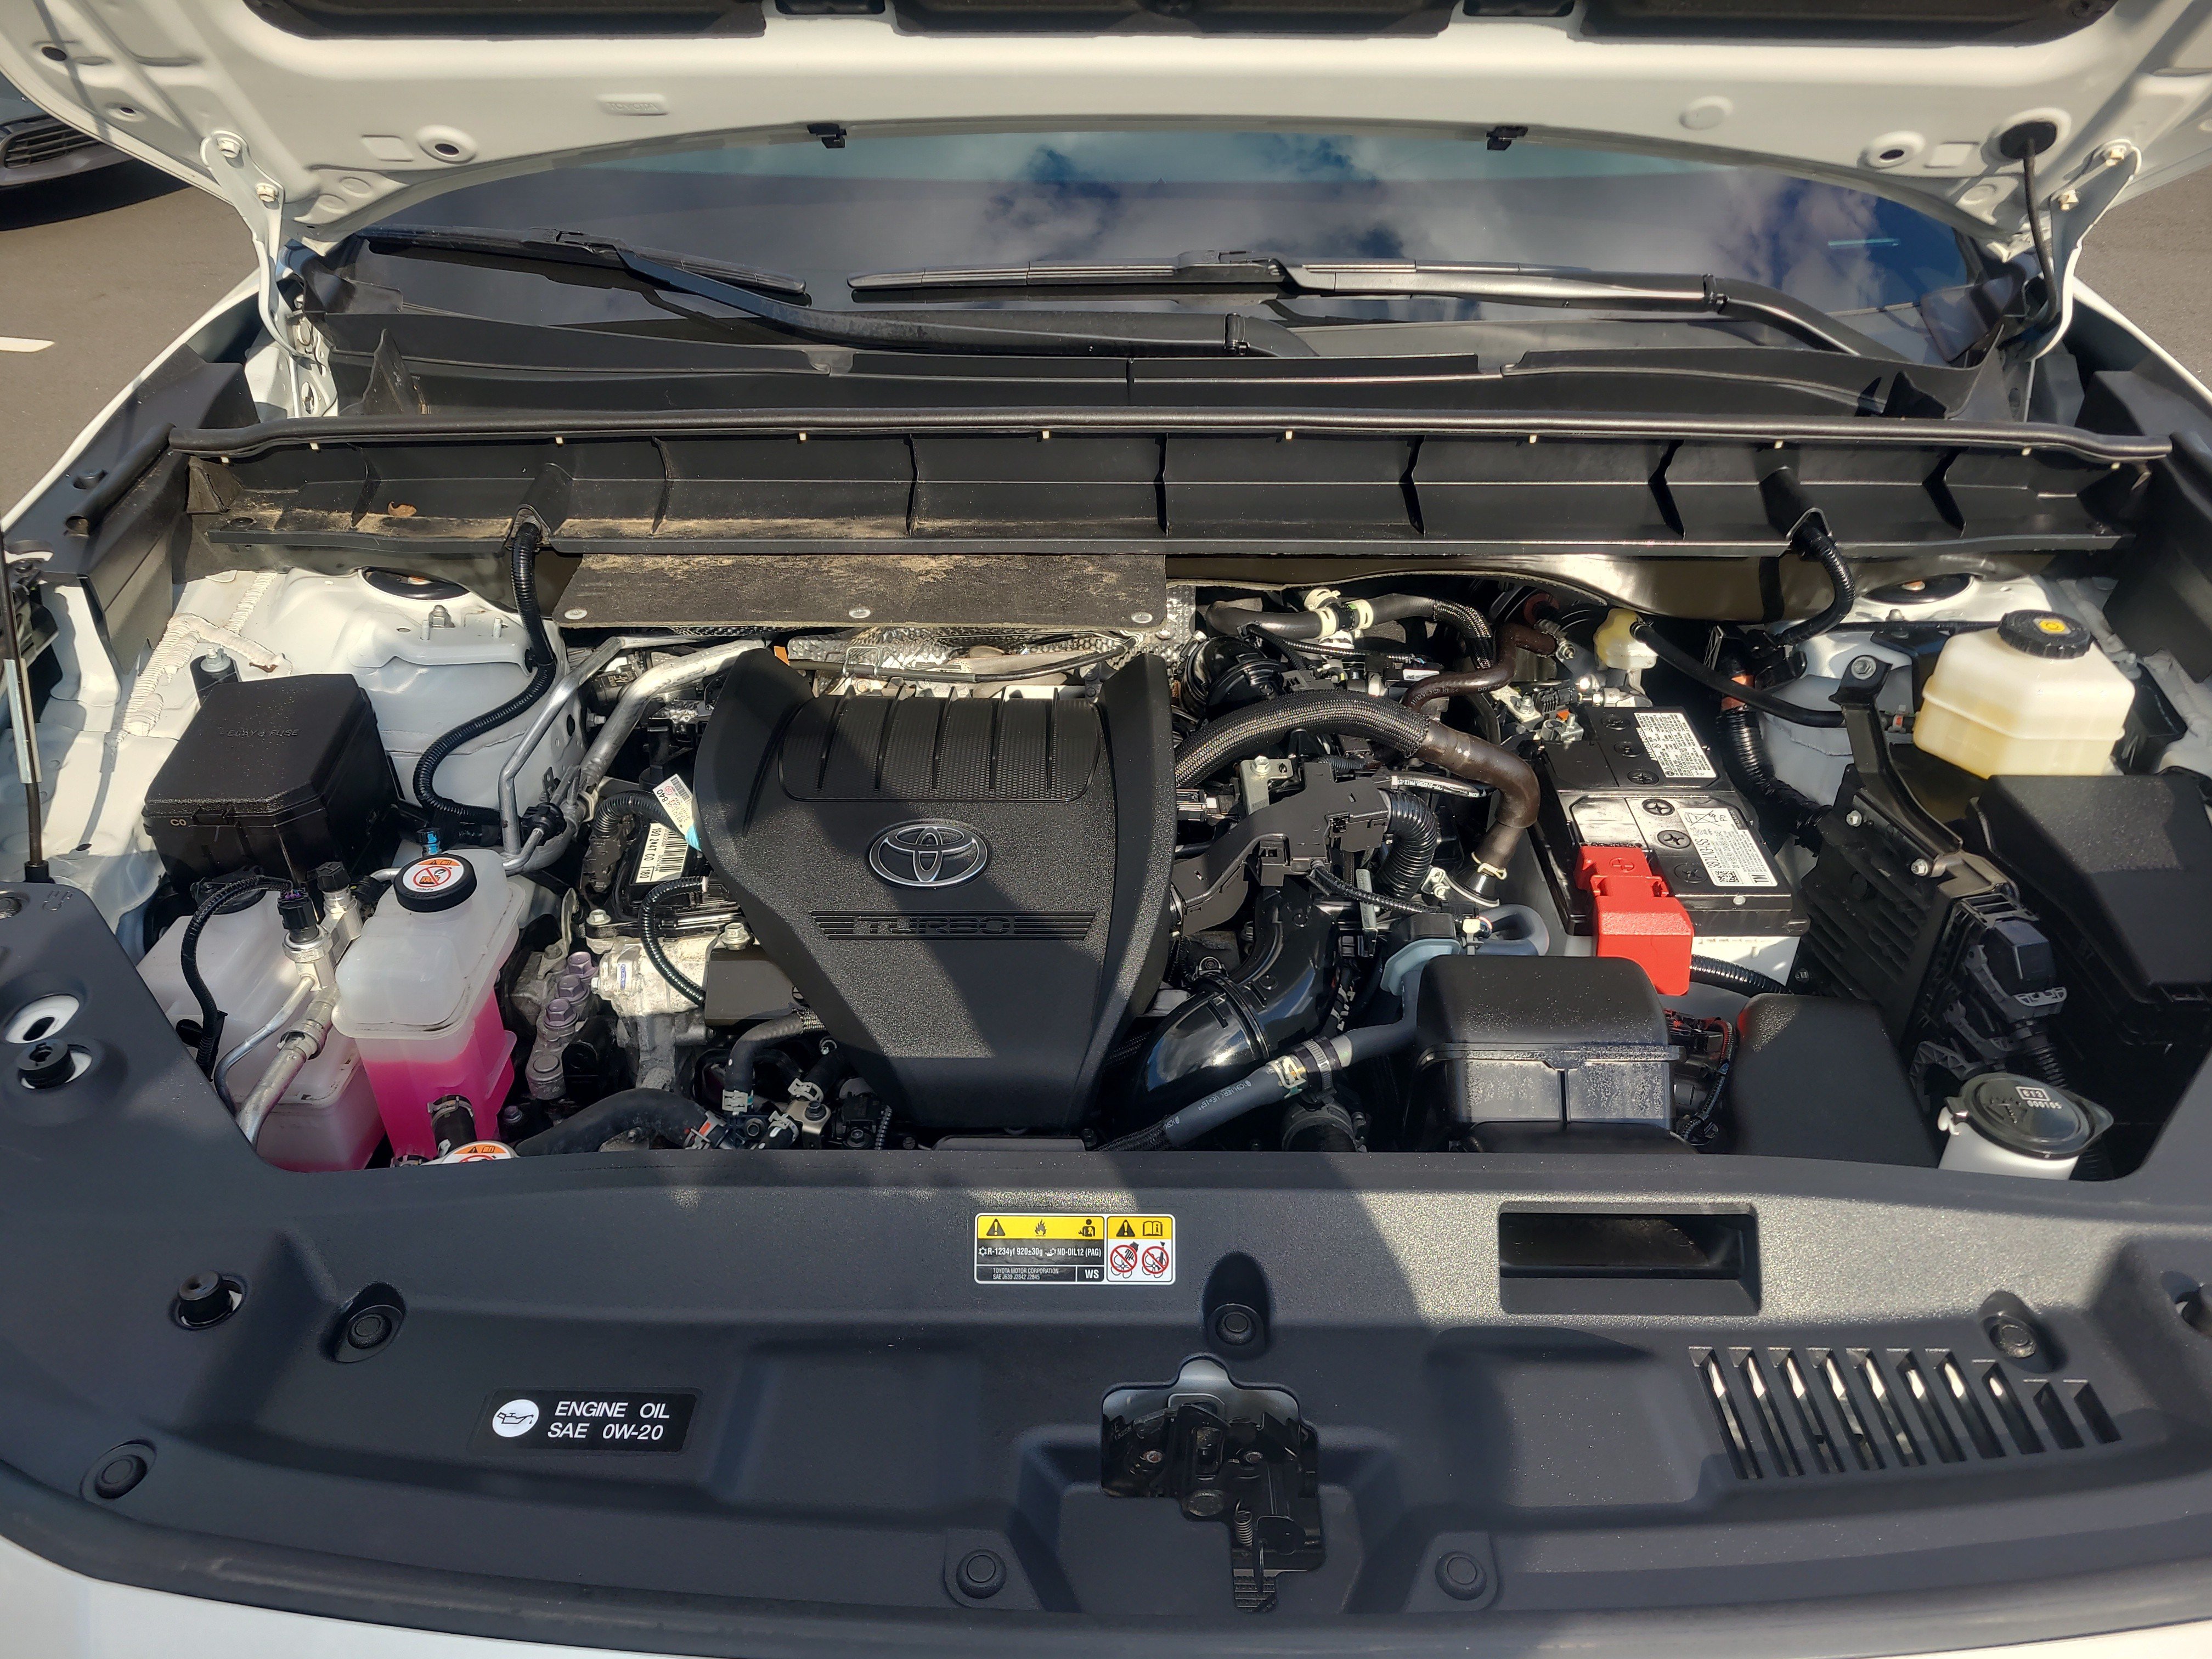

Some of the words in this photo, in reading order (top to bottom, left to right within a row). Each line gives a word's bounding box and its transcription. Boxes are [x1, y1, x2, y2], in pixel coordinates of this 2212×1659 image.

[606, 103, 658, 111] TOYOTA
[1753, 875, 1769, 884] TM
[859, 916, 1011, 935] TURBO
[1017, 1248, 1043, 1257] 920±30g
[1057, 1248, 1084, 1256] ND-OIL12
[1085, 1248, 1102, 1257] (PAG)
[1085, 1269, 1099, 1279] WS
[555, 1401, 628, 1418] ENGINE
[639, 1402, 670, 1419] OIL
[548, 1423, 590, 1438] SAE
[602, 1424, 664, 1440] 0W-20
